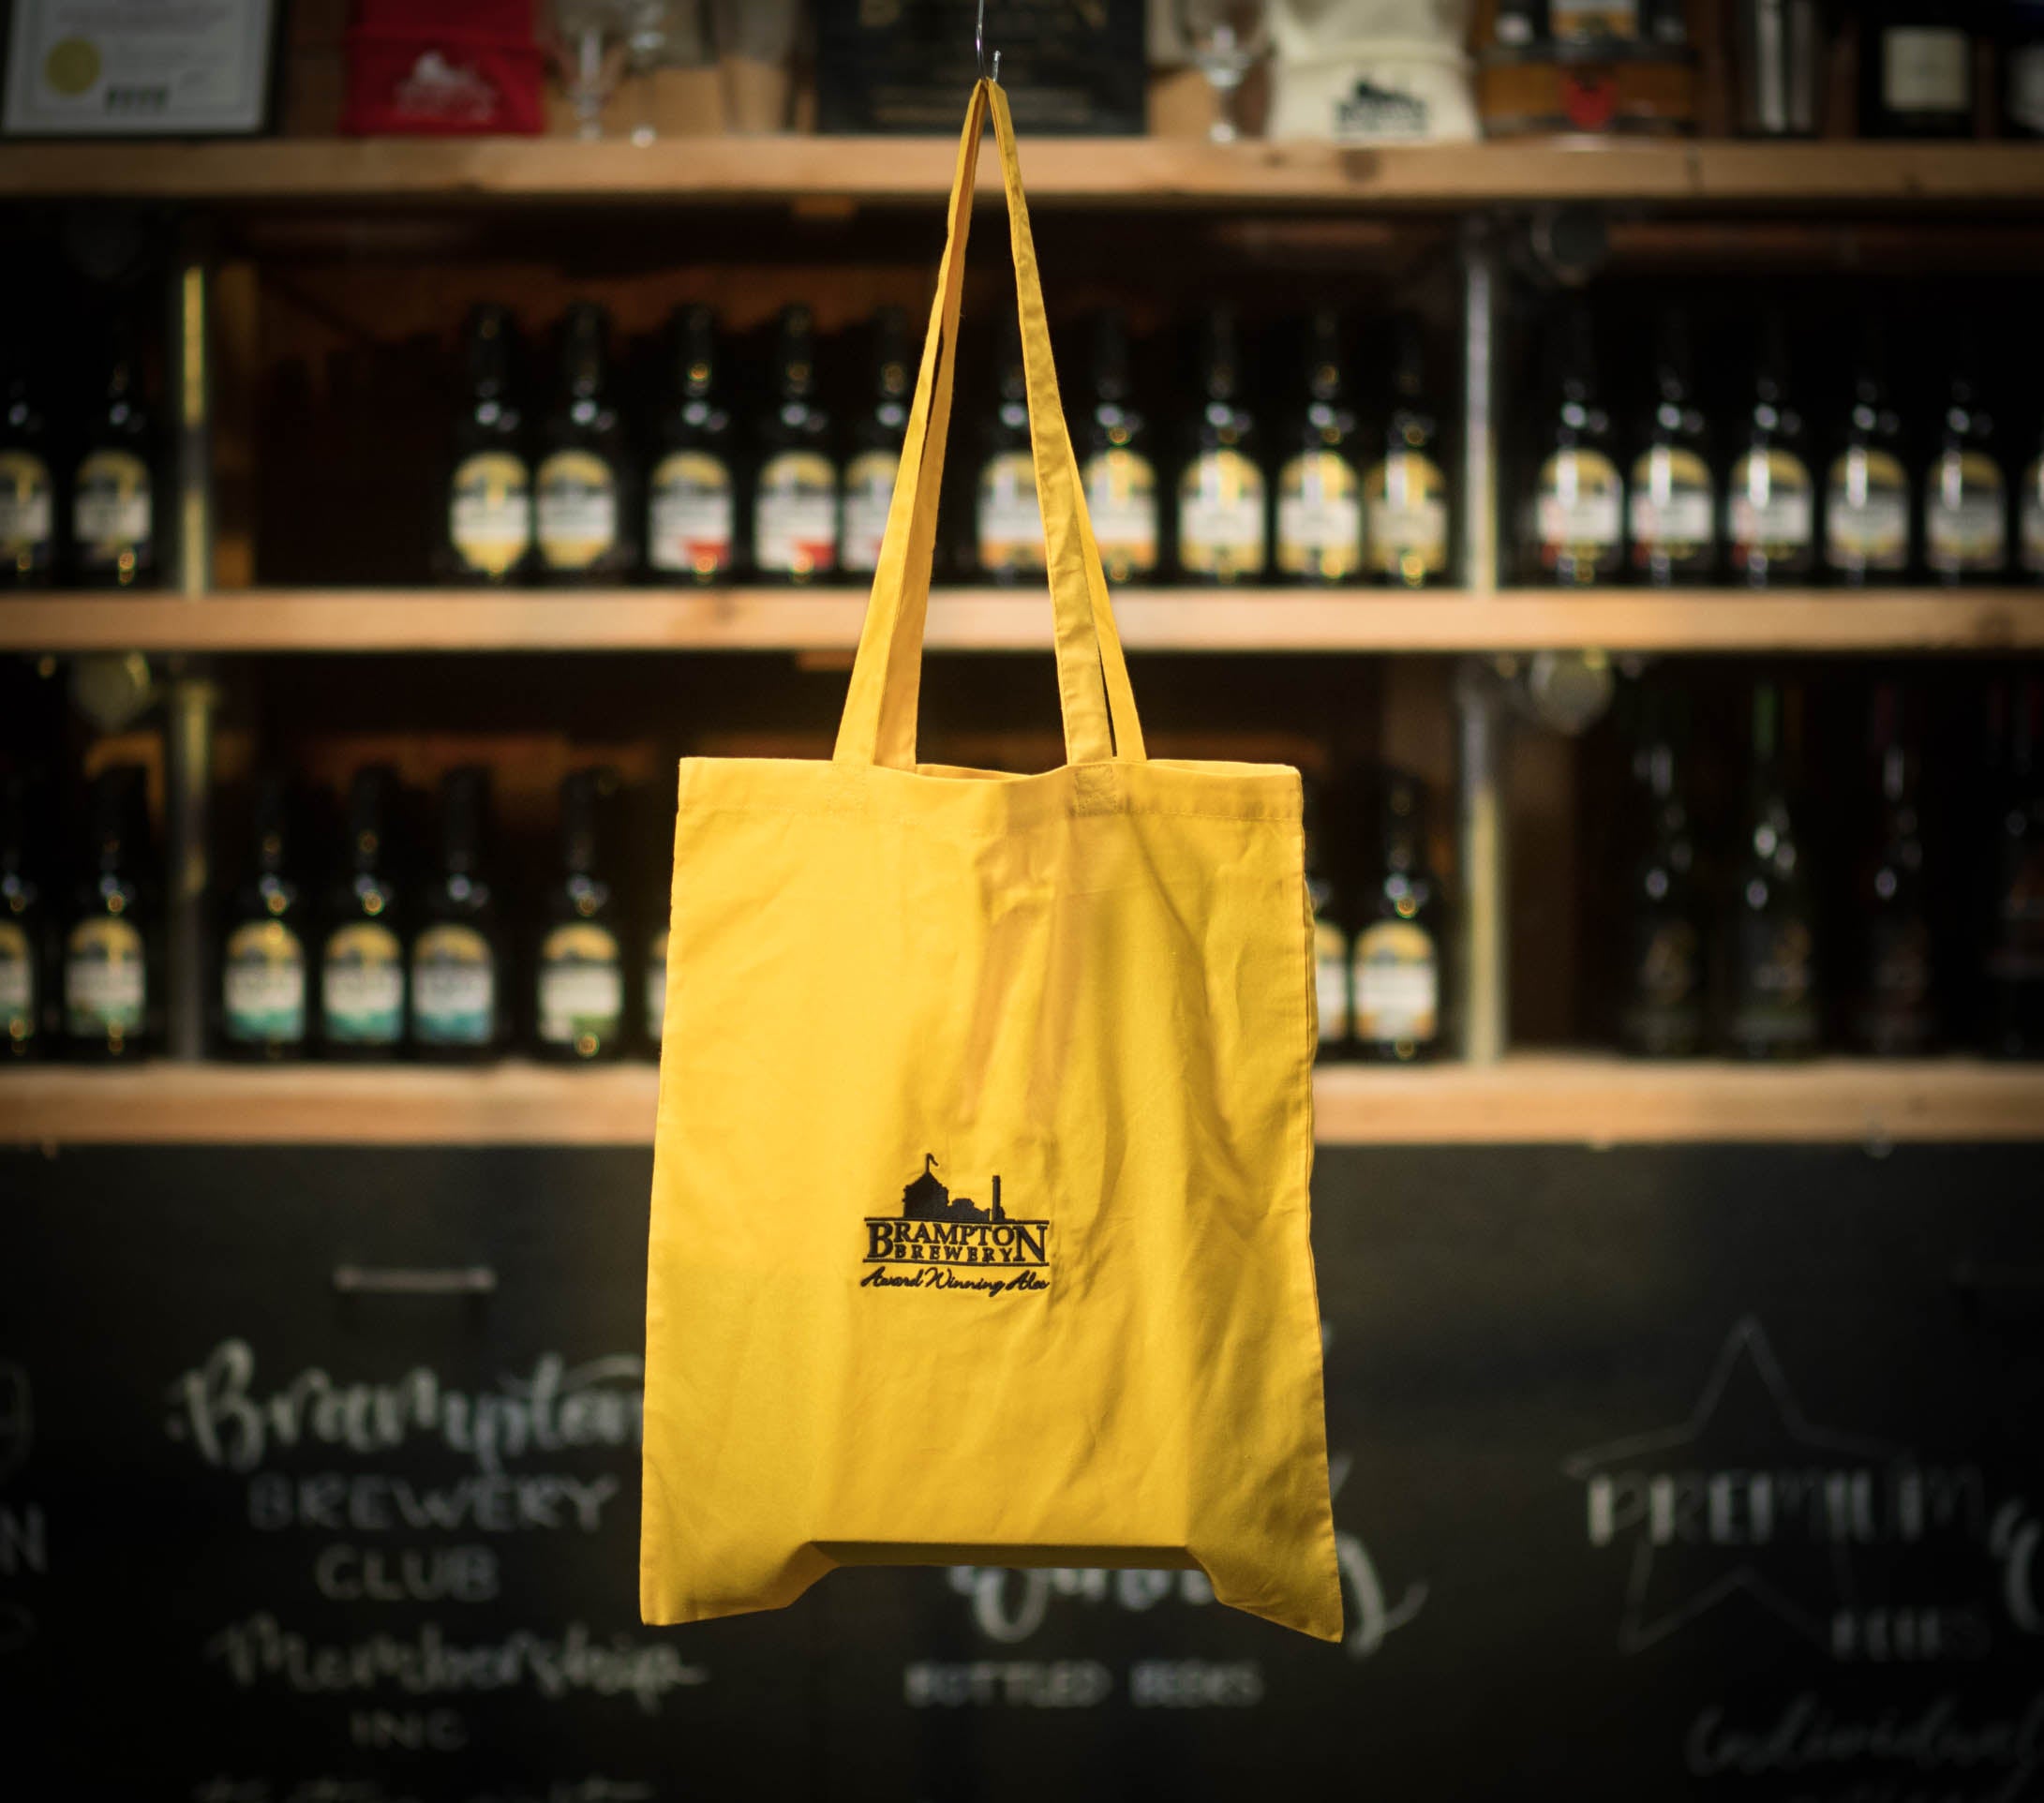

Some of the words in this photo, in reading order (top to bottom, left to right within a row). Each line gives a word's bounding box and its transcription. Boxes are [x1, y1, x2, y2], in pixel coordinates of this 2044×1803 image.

[866, 1221, 1049, 1262] BRAMPTON
[895, 1244, 1013, 1262] BREWERY
[860, 1266, 923, 1288] Award
[924, 1266, 1006, 1297] Winning
[1006, 1270, 1050, 1290] Ales
[247, 1473, 619, 1531] BREWERY
[315, 1544, 500, 1601] CLUB
